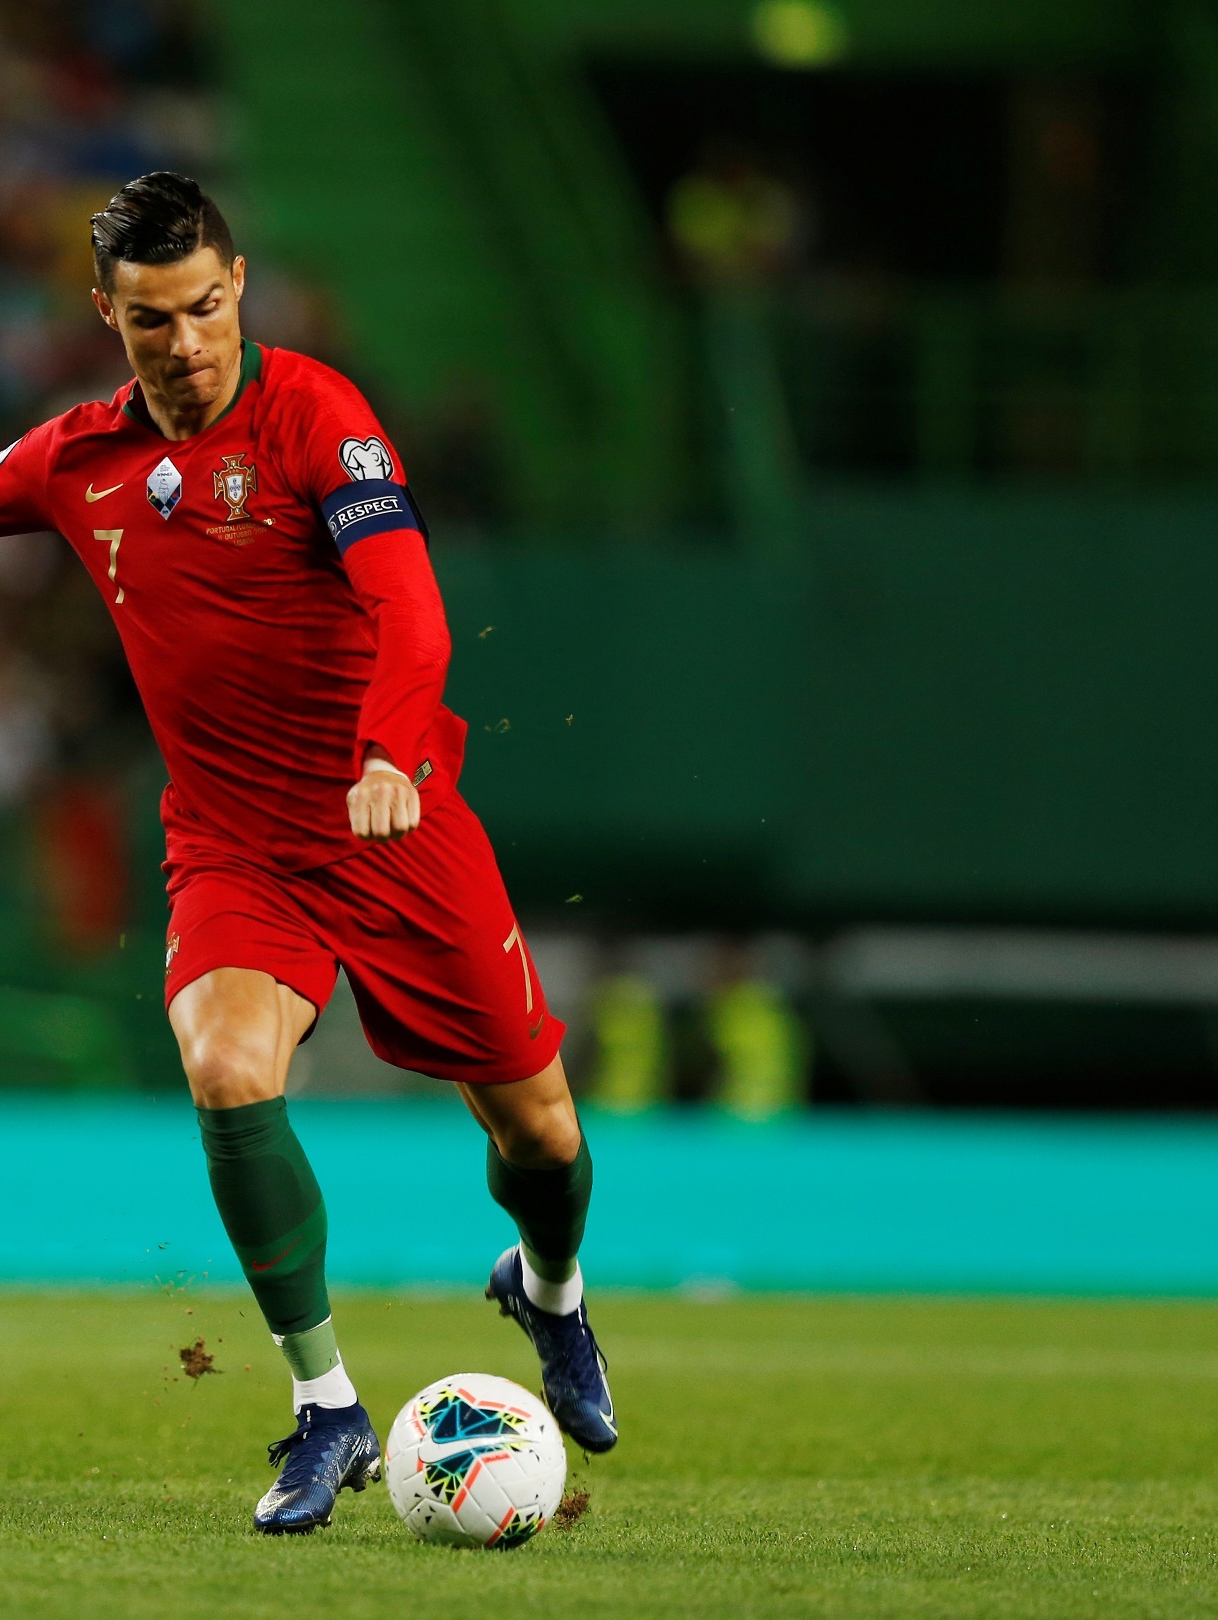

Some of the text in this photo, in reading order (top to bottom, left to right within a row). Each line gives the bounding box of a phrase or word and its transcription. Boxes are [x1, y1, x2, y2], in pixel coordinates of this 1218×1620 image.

[337, 499, 399, 526] RESPECT
[93, 529, 124, 604] 7
[503, 923, 533, 1014] 7
